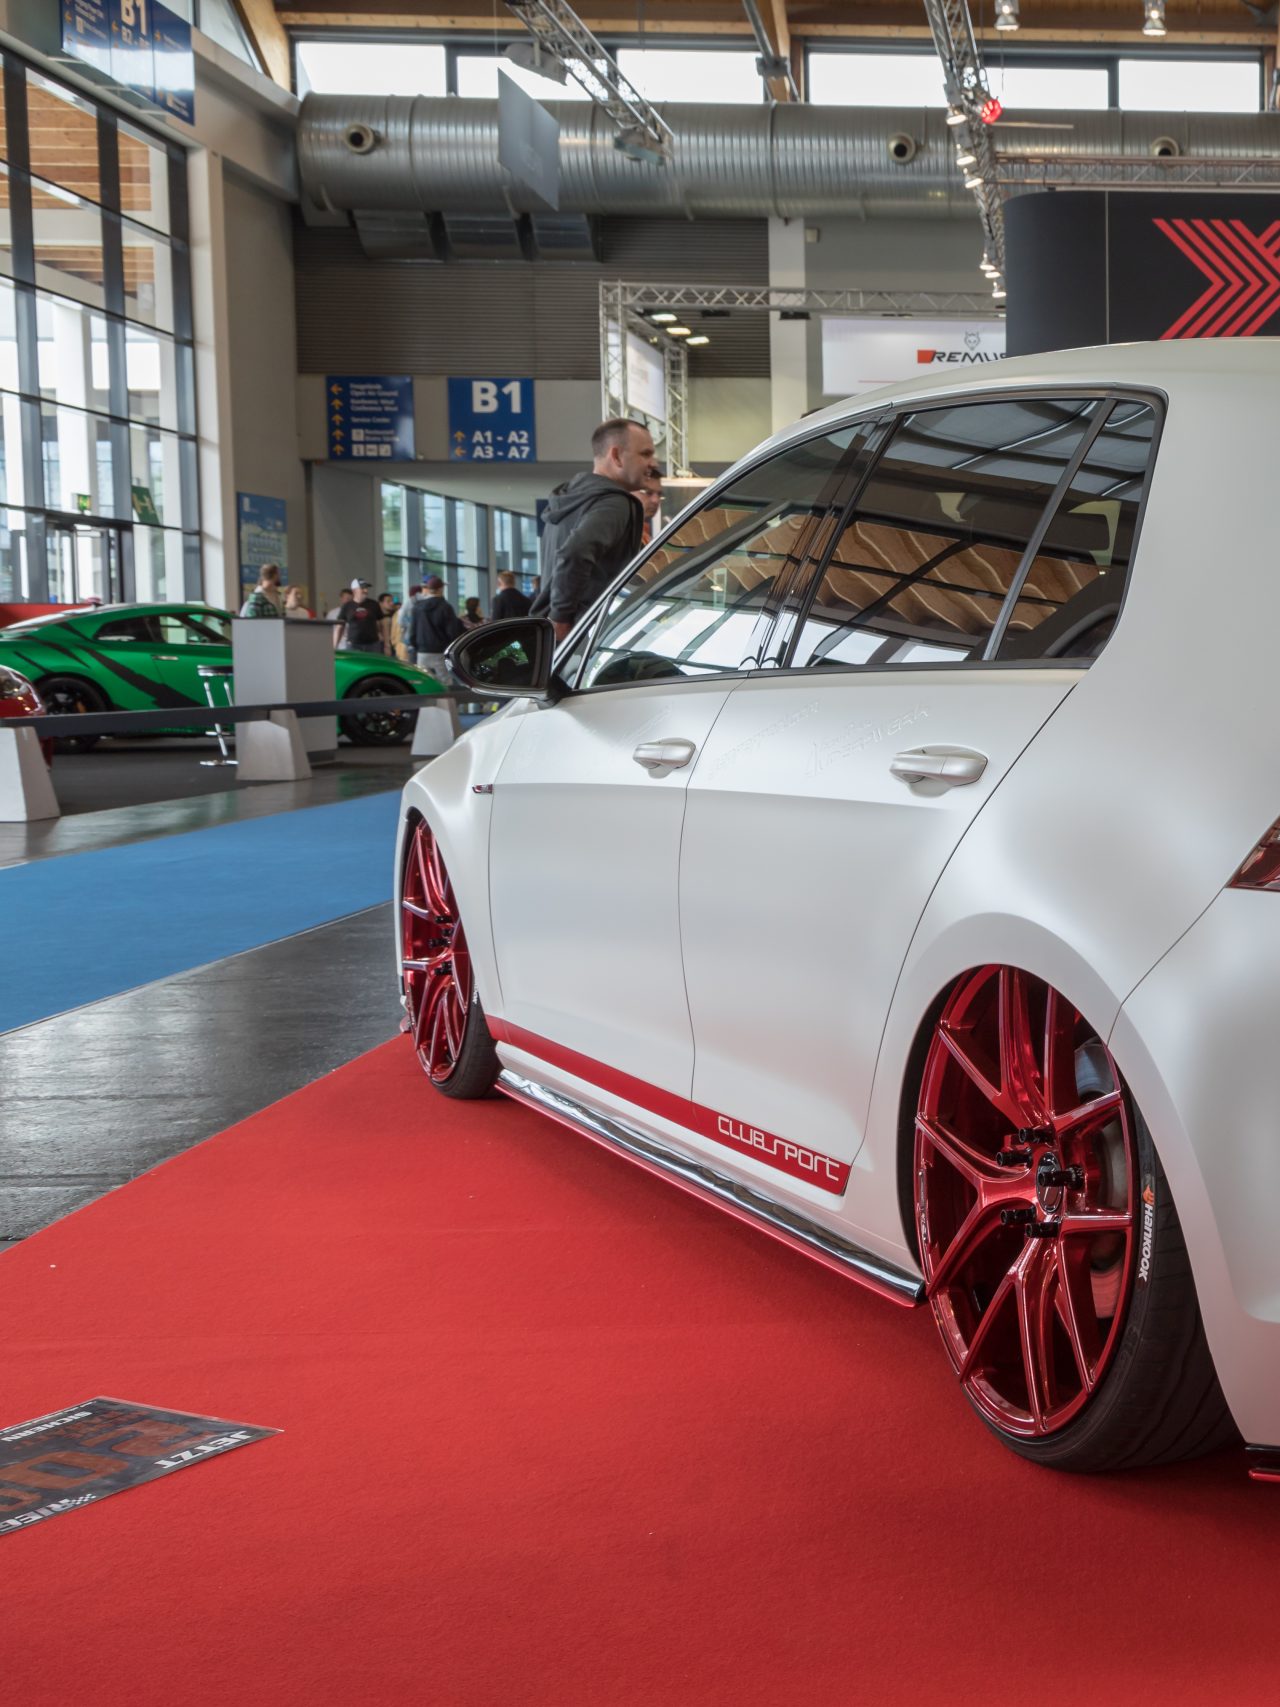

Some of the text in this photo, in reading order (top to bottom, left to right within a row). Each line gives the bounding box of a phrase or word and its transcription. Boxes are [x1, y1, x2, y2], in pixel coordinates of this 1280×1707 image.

[472, 381, 522, 413] B1
[472, 430, 493, 444] A1
[507, 430, 529, 444] A2
[472, 446, 495, 459] A3
[507, 446, 530, 459] A7
[717, 1115, 841, 1182] CLUBSPORT
[1138, 1202, 1155, 1283] Hankook
[154, 1430, 252, 1469] JETZT
